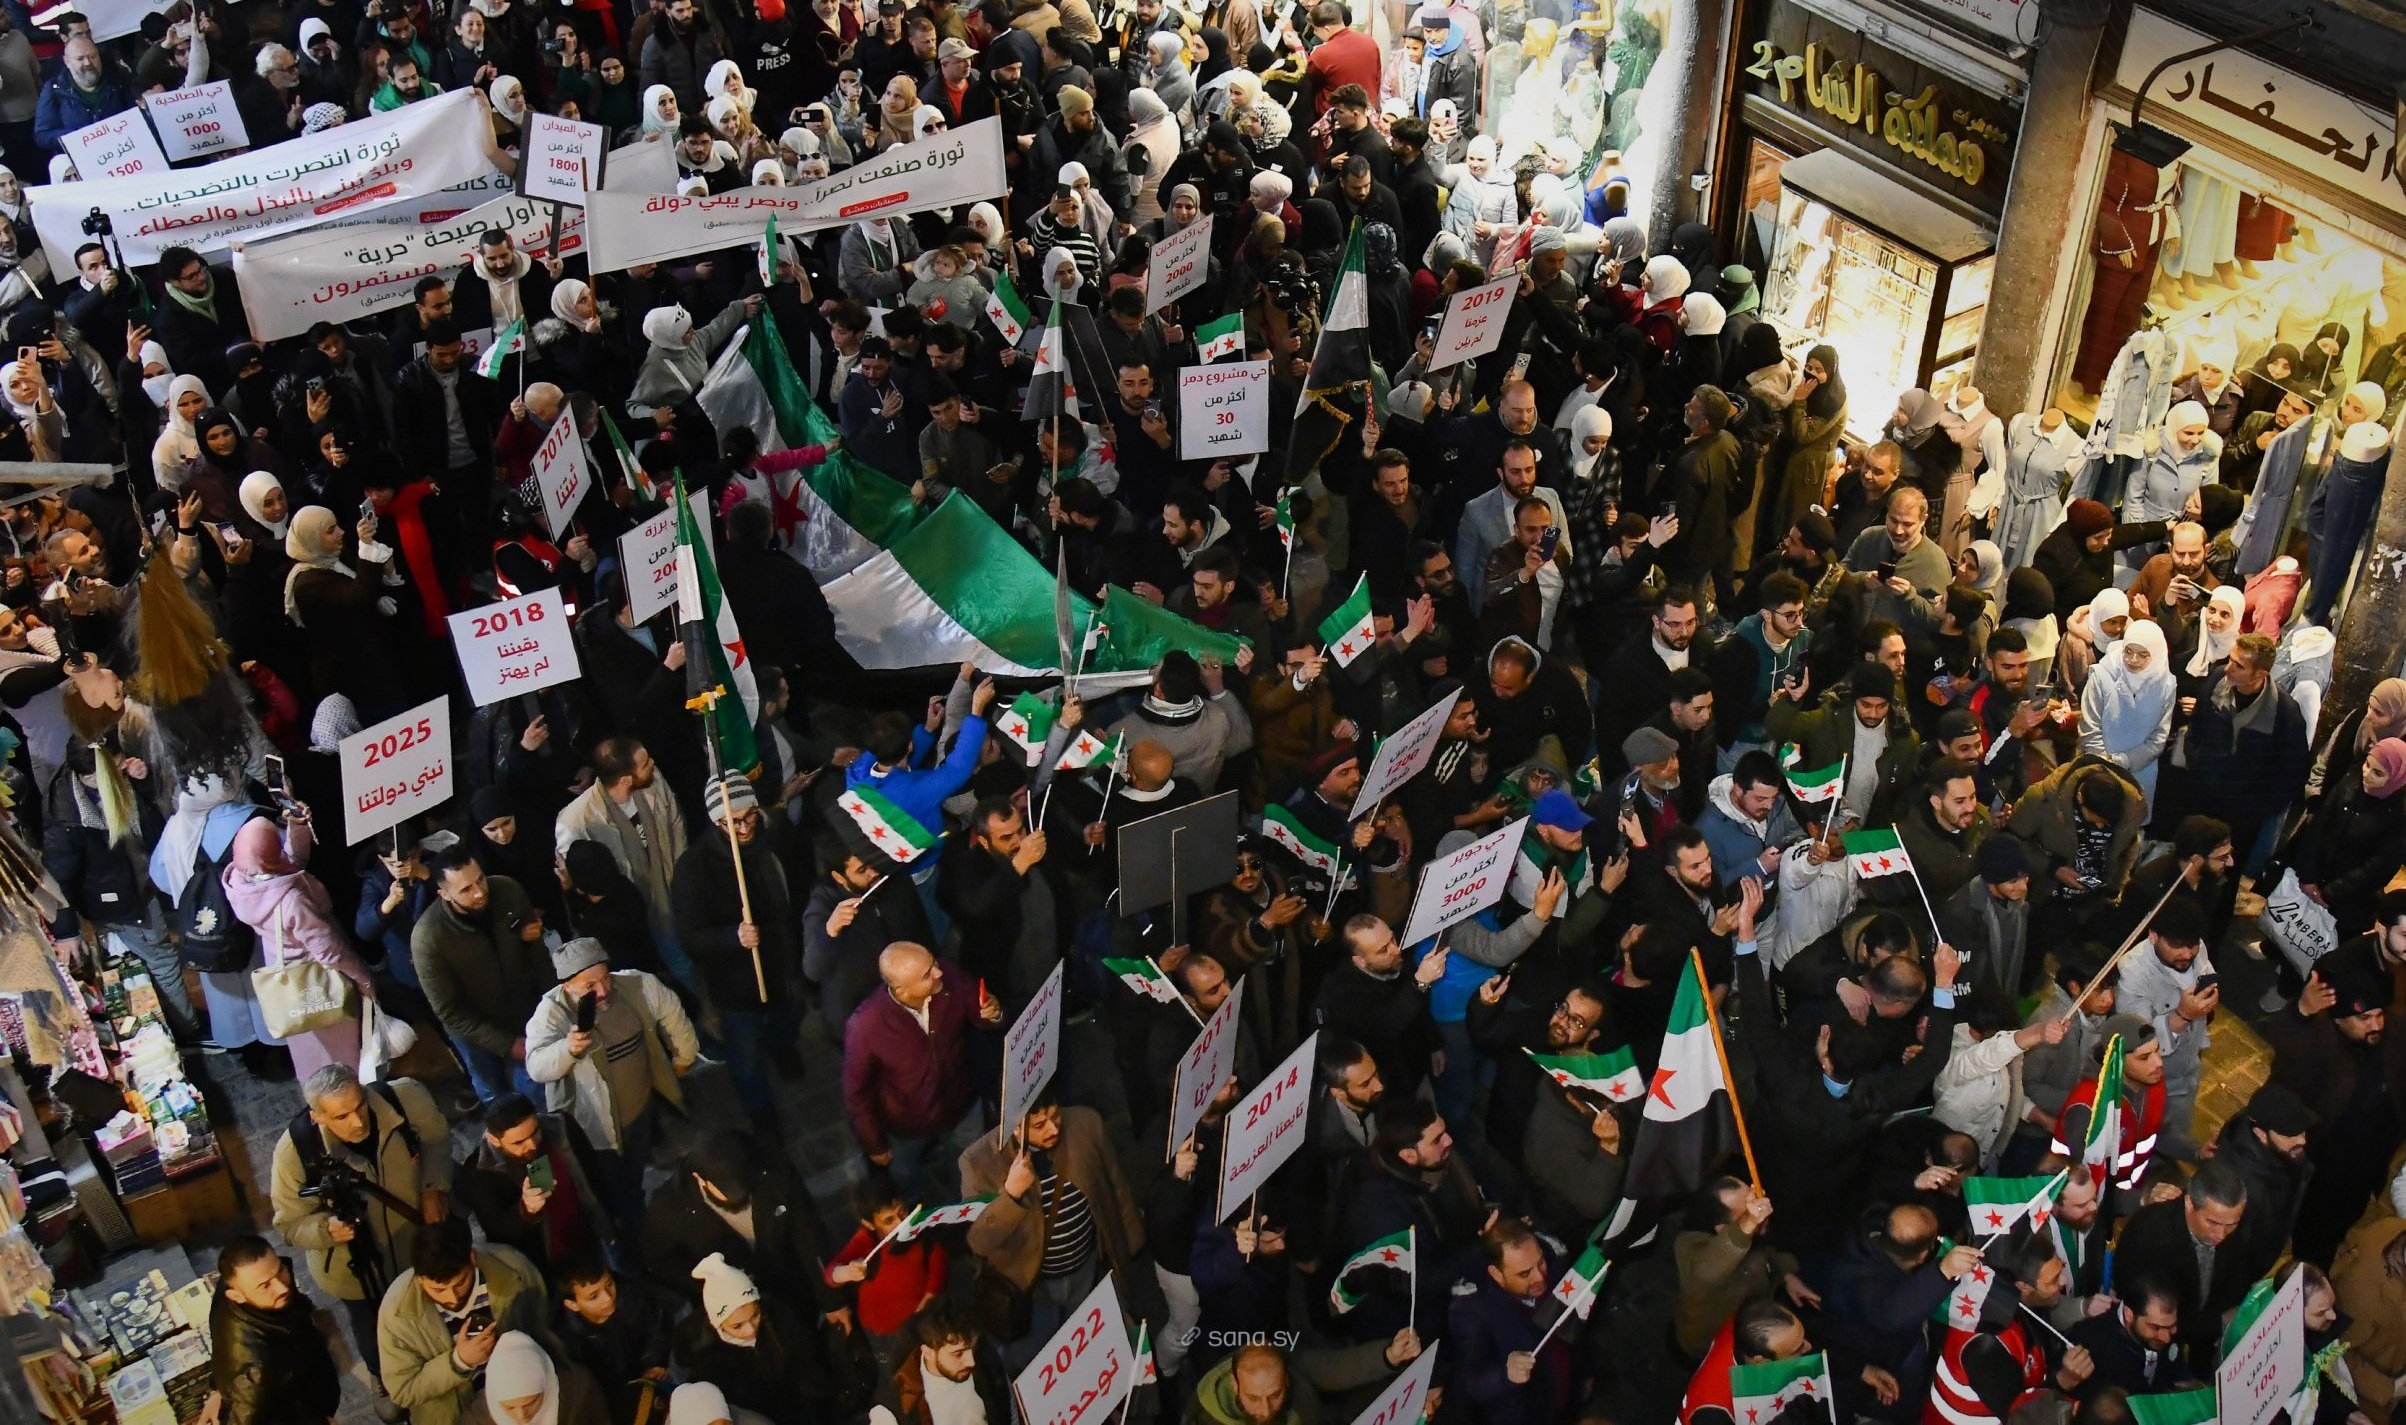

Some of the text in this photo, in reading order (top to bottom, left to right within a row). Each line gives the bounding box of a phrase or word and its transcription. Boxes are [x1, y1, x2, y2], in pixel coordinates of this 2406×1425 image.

[757, 52, 790, 70] PRESS
[155, 86, 222, 106] حي الصالحية
[1773, 42, 1877, 135] الشام
[176, 103, 217, 123] أكثر من
[2165, 62, 2396, 182] الحفار
[82, 120, 128, 147] حي القدم
[183, 121, 220, 137] 1000
[542, 120, 592, 139] حي الميدان
[1883, 84, 1985, 186] مملكة
[97, 137, 135, 165] أكثر من
[190, 136, 224, 151] شهيد
[358, 132, 400, 162] ثورة
[548, 143, 564, 151] من
[927, 140, 964, 169] ثورة
[107, 159, 143, 177] 1500
[266, 148, 350, 182] انتصرت
[549, 158, 578, 172] 1800
[858, 160, 921, 184] صنعت
[547, 176, 576, 188] شهيد
[245, 187, 315, 217] بالبذل
[744, 196, 798, 210] ونصر
[424, 219, 487, 247] صيحة
[1198, 221, 1210, 234] حي
[1155, 237, 1177, 257] الدين
[1165, 255, 1179, 269] من
[1166, 261, 1193, 284] 2000
[313, 263, 437, 303] مستمرون
[1164, 277, 1190, 298] شهيد
[1461, 287, 1504, 311] 2019
[1464, 315, 1487, 328] عزمنا
[1183, 368, 1267, 386] حي مشروع دمر
[1205, 387, 1245, 407] أكثر من
[1216, 412, 1234, 425] 30
[540, 416, 571, 473] 2013
[1208, 429, 1242, 444] شهيد
[555, 462, 579, 511] ثبتنا
[645, 520, 667, 537] برزة
[649, 548, 667, 564] من
[657, 582, 678, 600] هيد
[471, 602, 544, 638] 2018
[497, 638, 539, 658] يقيننا
[499, 656, 550, 684] لم يهتز
[1422, 709, 1438, 726] حي
[364, 718, 432, 768] 2025
[1390, 746, 1408, 763] من
[1386, 748, 1420, 777] 1200
[358, 759, 444, 813] نبني دولتنا
[1377, 766, 1410, 794] شهيد
[1451, 833, 1506, 868] حي جوبر
[1445, 852, 1497, 890] أكثر من
[1441, 876, 1487, 908] 3000
[1436, 897, 1479, 924] شهيد
[1049, 974, 1060, 997] حي
[289, 1001, 340, 1018] CHANEL
[1191, 1001, 1231, 1071] 2011
[1020, 1040, 1033, 1064] من
[1022, 1041, 1045, 1083] 1000
[1021, 1067, 1044, 1107] شهيد
[1245, 1065, 1298, 1131] 2014
[1229, 1101, 1304, 1182] تابعنا العزيمة
[2286, 1286, 2300, 1310] حي
[2248, 1306, 2283, 1359] مساكن
[1039, 1307, 1105, 1396] 2022
[2246, 1363, 2262, 1387] من
[2253, 1364, 2276, 1399] 100
[2251, 1384, 2279, 1422] شهيد
